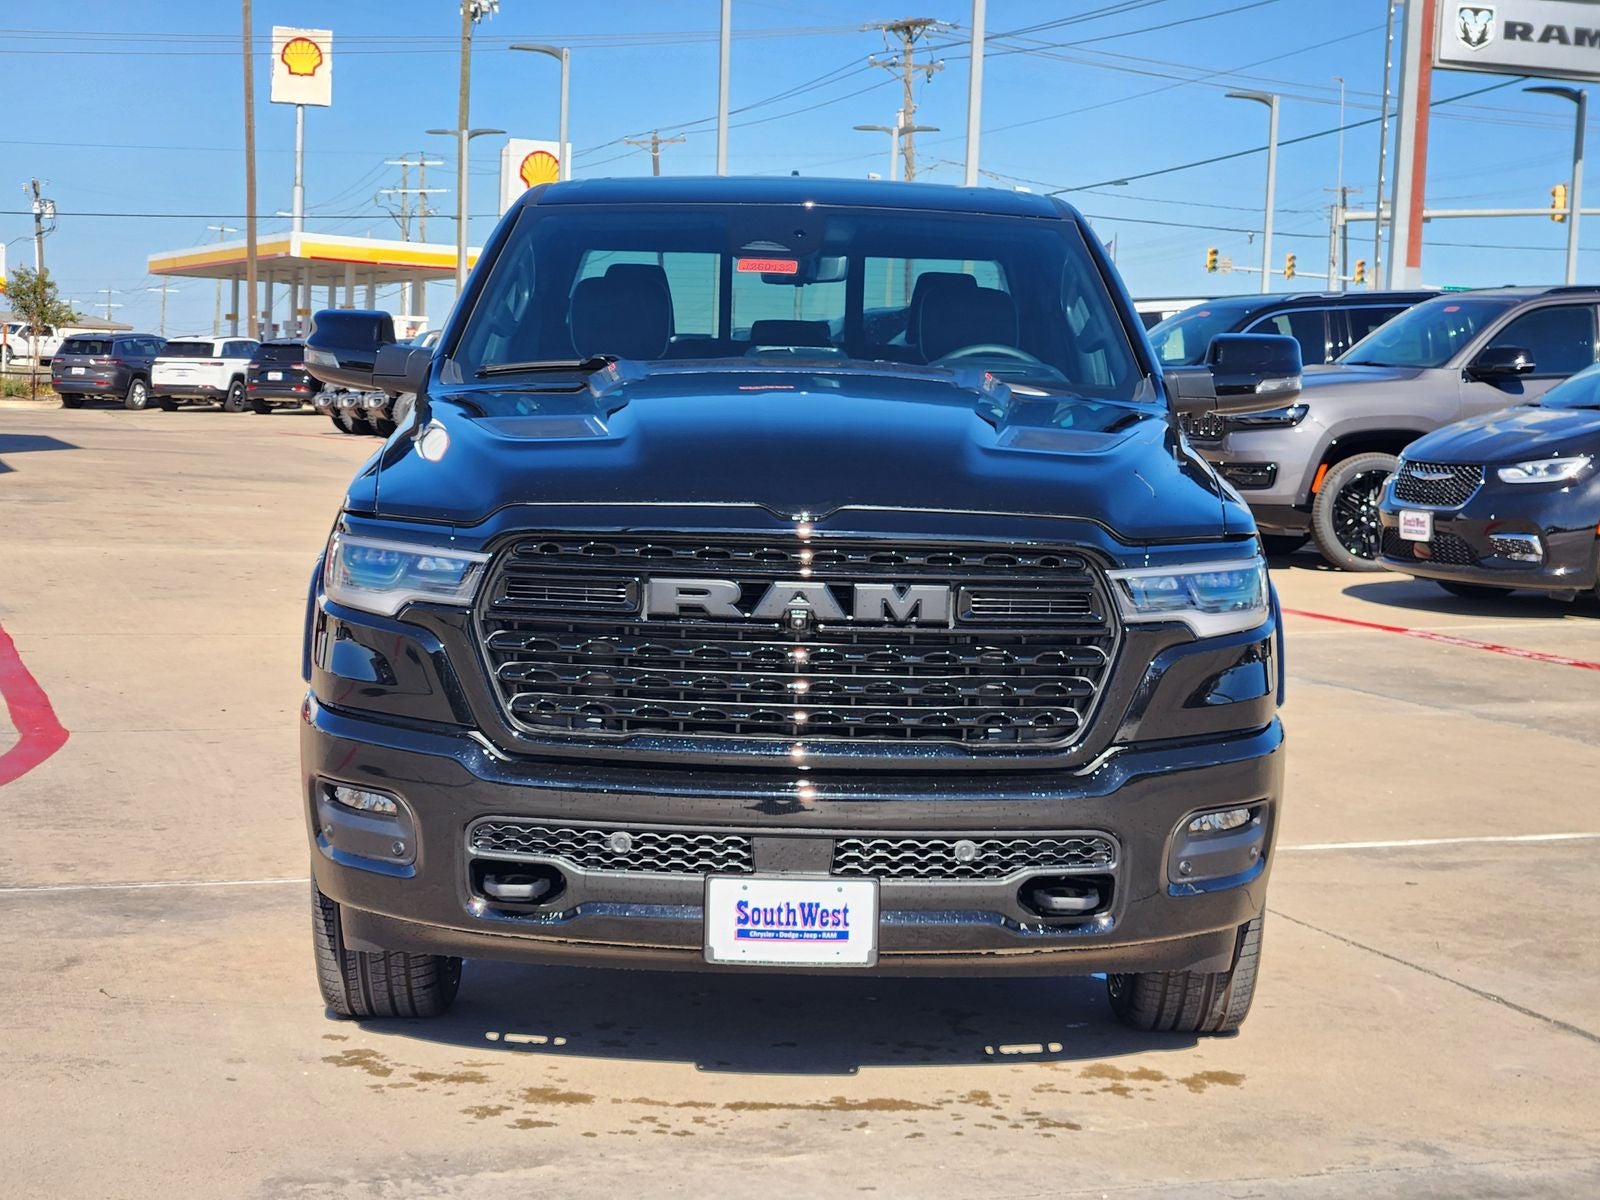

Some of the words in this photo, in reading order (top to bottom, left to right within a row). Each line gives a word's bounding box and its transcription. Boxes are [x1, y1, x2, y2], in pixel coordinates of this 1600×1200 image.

[1503, 20, 1600, 48] RAM
[647, 577, 950, 621] RAM
[749, 931, 775, 939] Chrysler
[779, 931, 799, 940] Dodge
[803, 932, 817, 940] Jeep
